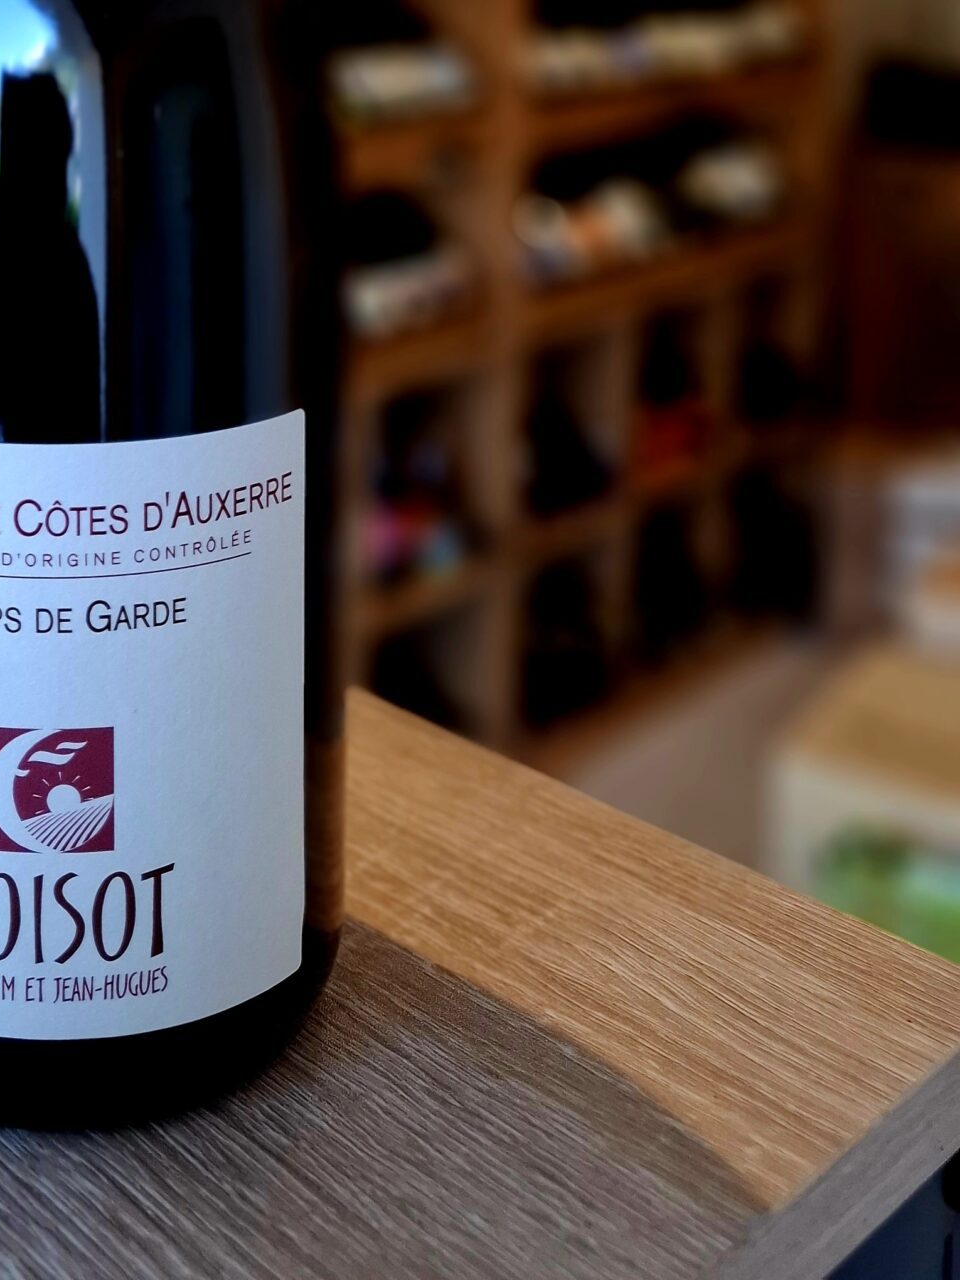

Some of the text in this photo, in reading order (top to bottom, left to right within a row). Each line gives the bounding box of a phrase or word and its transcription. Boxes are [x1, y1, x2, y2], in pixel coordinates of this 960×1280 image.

[13, 498, 130, 538] CÔTES
[143, 471, 294, 532] D'AUXERRE
[1, 551, 121, 569] D'ORIGINE
[133, 528, 253, 565] CONTRÔLÉE
[35, 607, 74, 634] DE
[85, 597, 188, 634] GARDE
[25, 976, 46, 1003] ET
[52, 965, 169, 1004] JEAN-HUGUES
